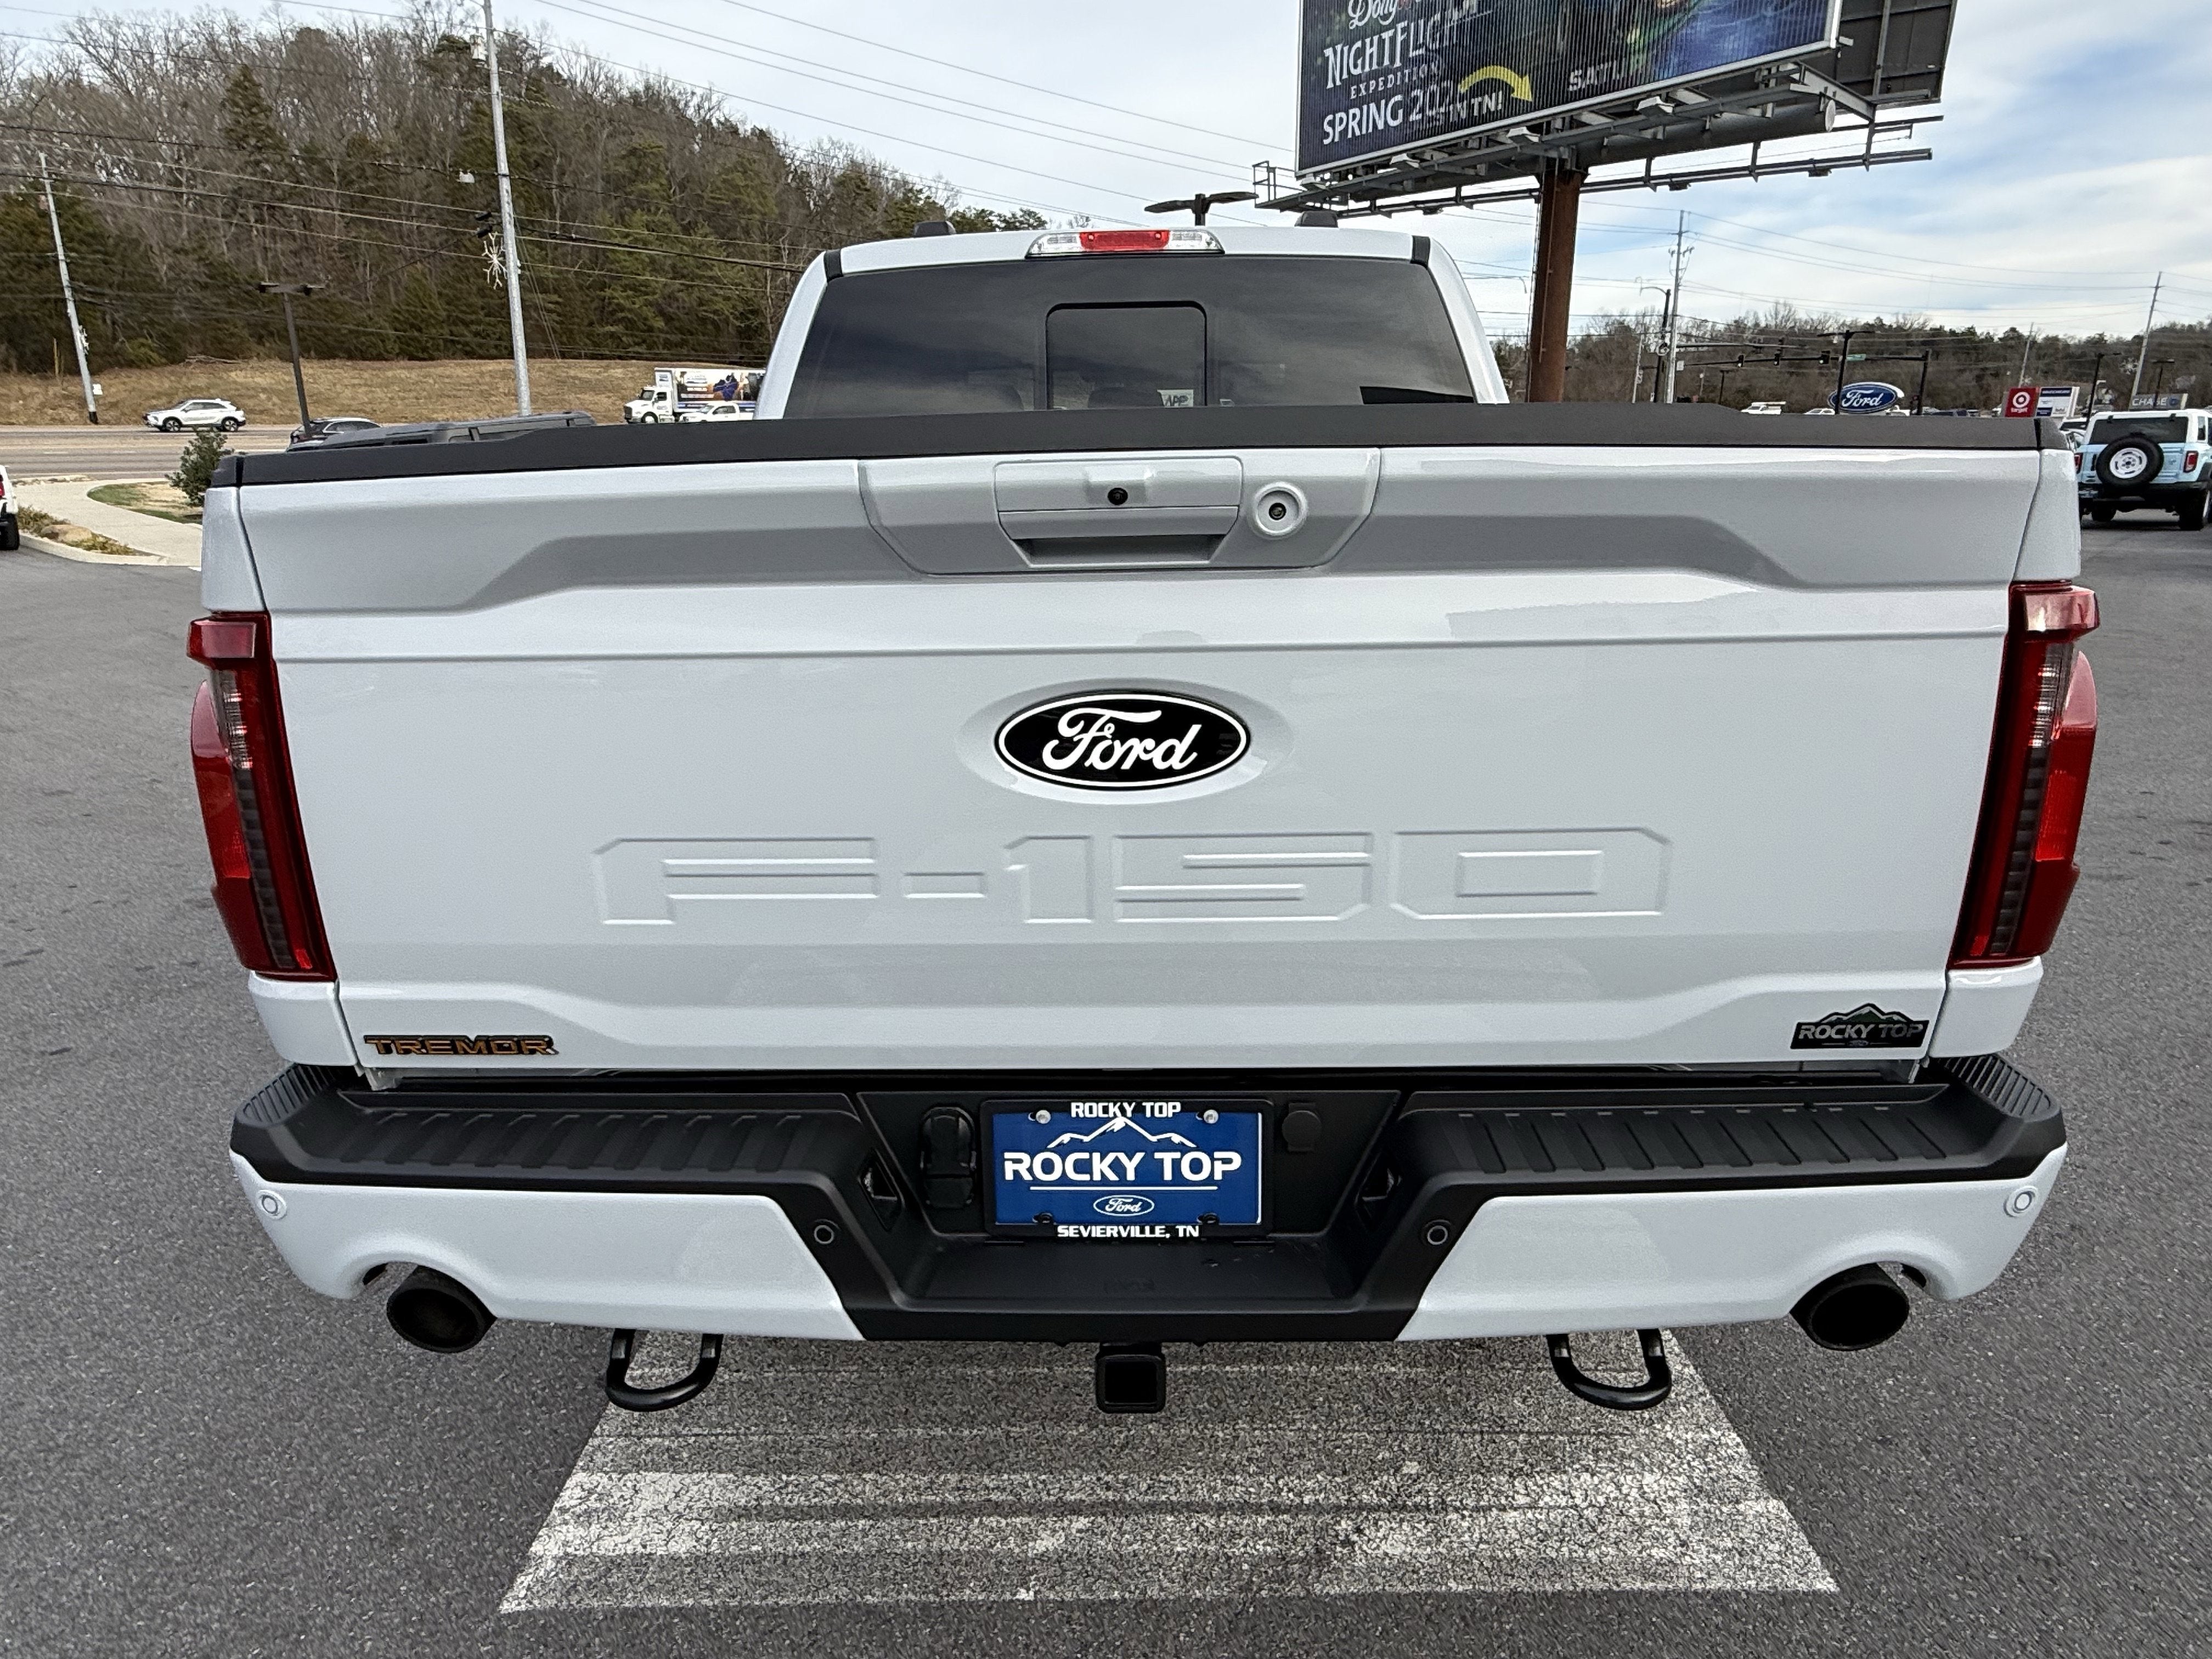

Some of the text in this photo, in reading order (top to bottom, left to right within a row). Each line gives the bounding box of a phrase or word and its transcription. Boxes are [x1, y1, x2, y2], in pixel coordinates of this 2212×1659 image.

[1323, 94, 1403, 145] SPRING
[1842, 390, 1883, 407] Ford
[1042, 708, 1202, 770] Ford
[591, 828, 1672, 924] F-150
[1798, 1024, 1923, 1039] ROCKY TOP
[363, 1035, 559, 1055] TREMOR
[1071, 1102, 1181, 1118] ROCKY TOP
[1003, 1152, 1242, 1181] ROCKY TOP
[1104, 1198, 1142, 1213] Ford
[1057, 1225, 1200, 1239] SEVIERVILLE, TN
